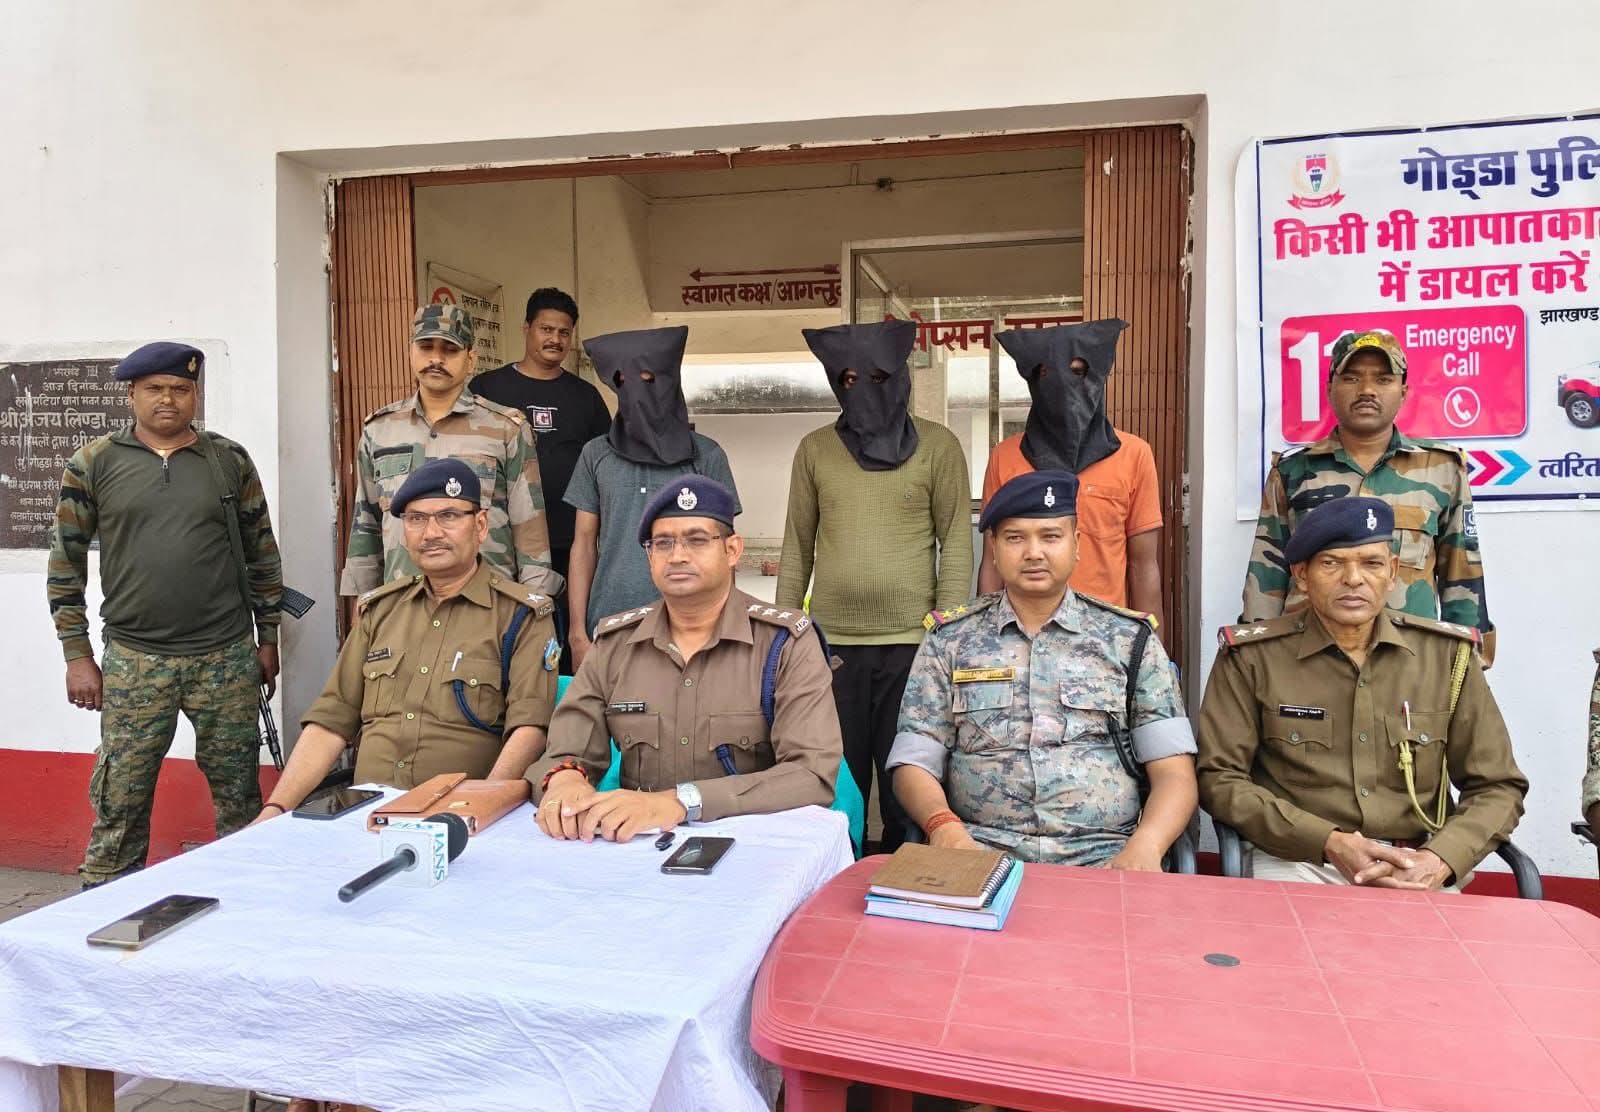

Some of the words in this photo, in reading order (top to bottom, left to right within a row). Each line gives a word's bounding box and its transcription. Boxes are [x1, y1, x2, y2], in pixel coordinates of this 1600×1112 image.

[1401, 147, 1518, 200] गोड्डा
[1274, 212, 1369, 260] किसी
[1377, 209, 1420, 251] भी
[1427, 207, 1600, 249] आपातका
[1378, 261, 1412, 302] में
[1418, 264, 1522, 300] डायल
[1530, 250, 1590, 293] करें
[681, 283, 737, 306] स्वागत
[1540, 307, 1600, 326] झारखण्ड
[1406, 324, 1516, 351] Emergency
[1443, 352, 1480, 377] Call
[1538, 451, 1600, 478] त्वरित
[434, 832, 445, 881] IANS
